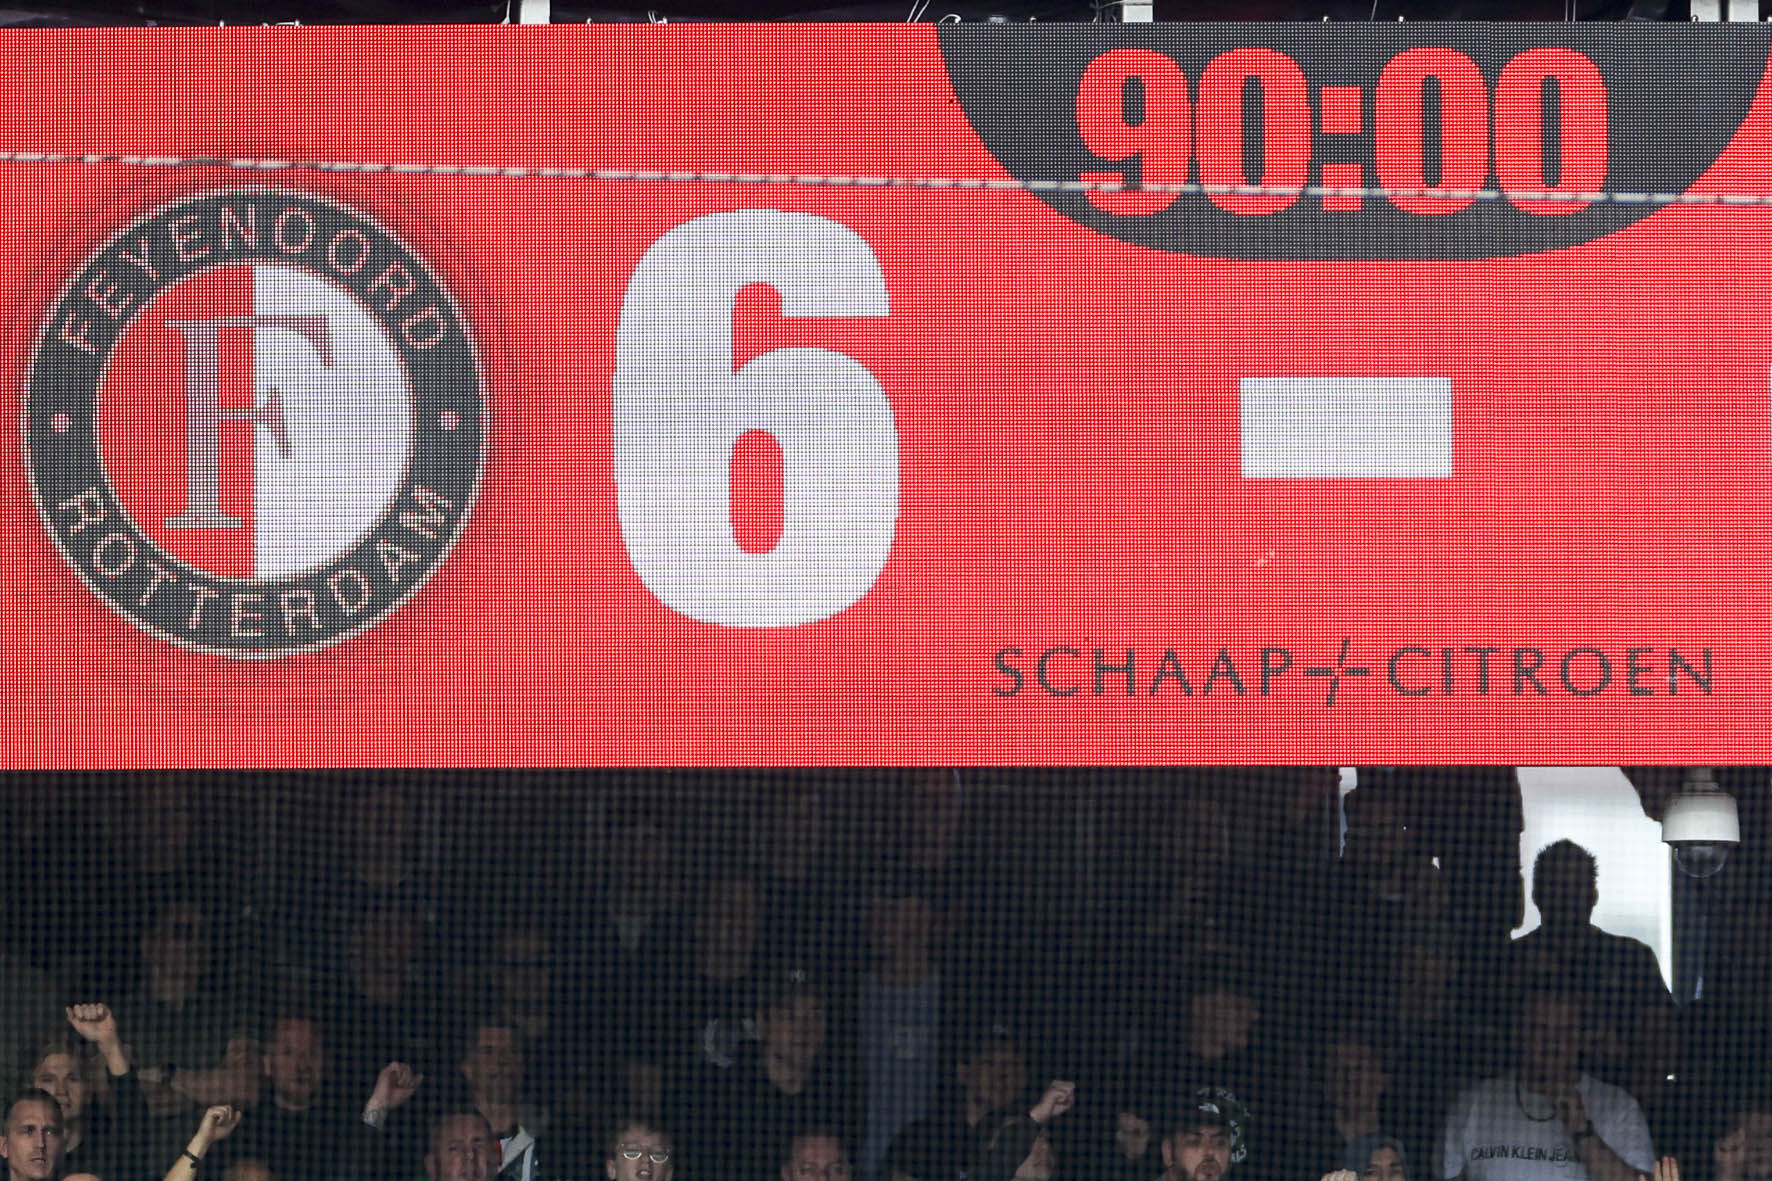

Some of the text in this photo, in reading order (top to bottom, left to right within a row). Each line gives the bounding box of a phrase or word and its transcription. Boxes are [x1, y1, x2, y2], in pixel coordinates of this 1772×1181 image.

[1076, 47, 1608, 216] 90:00
[59, 202, 451, 358] FEYENOORD
[164, 316, 335, 531] F
[611, 208, 901, 628] 6
[57, 485, 454, 640] ROTTERDAM
[1470, 1147, 1509, 1162] CALVIN
[1511, 1147, 1547, 1161] KLEIN
